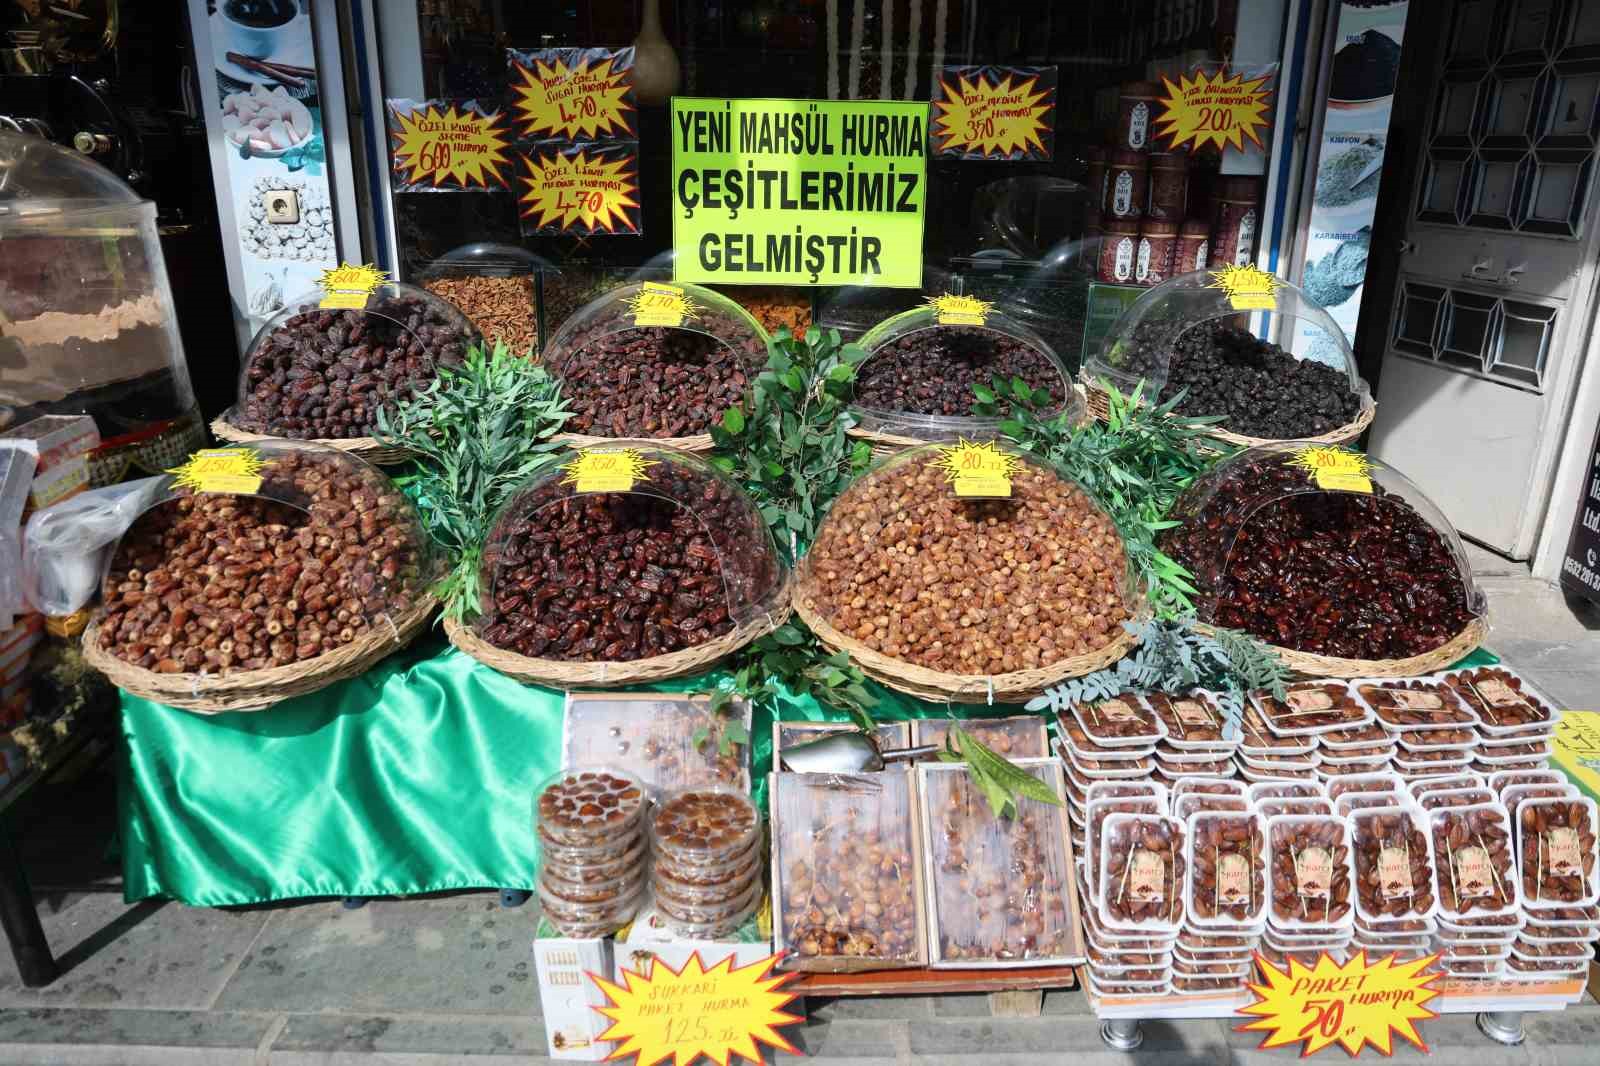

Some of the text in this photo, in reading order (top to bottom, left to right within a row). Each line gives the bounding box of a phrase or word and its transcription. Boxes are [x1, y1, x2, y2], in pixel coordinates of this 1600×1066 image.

[558, 95, 597, 123] 450
[1193, 107, 1232, 131] 200
[677, 101, 924, 157] YENİ MAHSÜL HURMA
[964, 118, 994, 141] 350
[419, 141, 450, 171] 600
[556, 191, 603, 214] 470
[678, 160, 919, 220] ÇEŞİTLERİMİZ
[699, 225, 882, 283] GELMİŞTİR
[1291, 975, 1371, 996] PAKET
[638, 999, 751, 1017] PAKET HURMA
[1350, 990, 1415, 1009] HURMA
[1298, 999, 1345, 1038] 50
